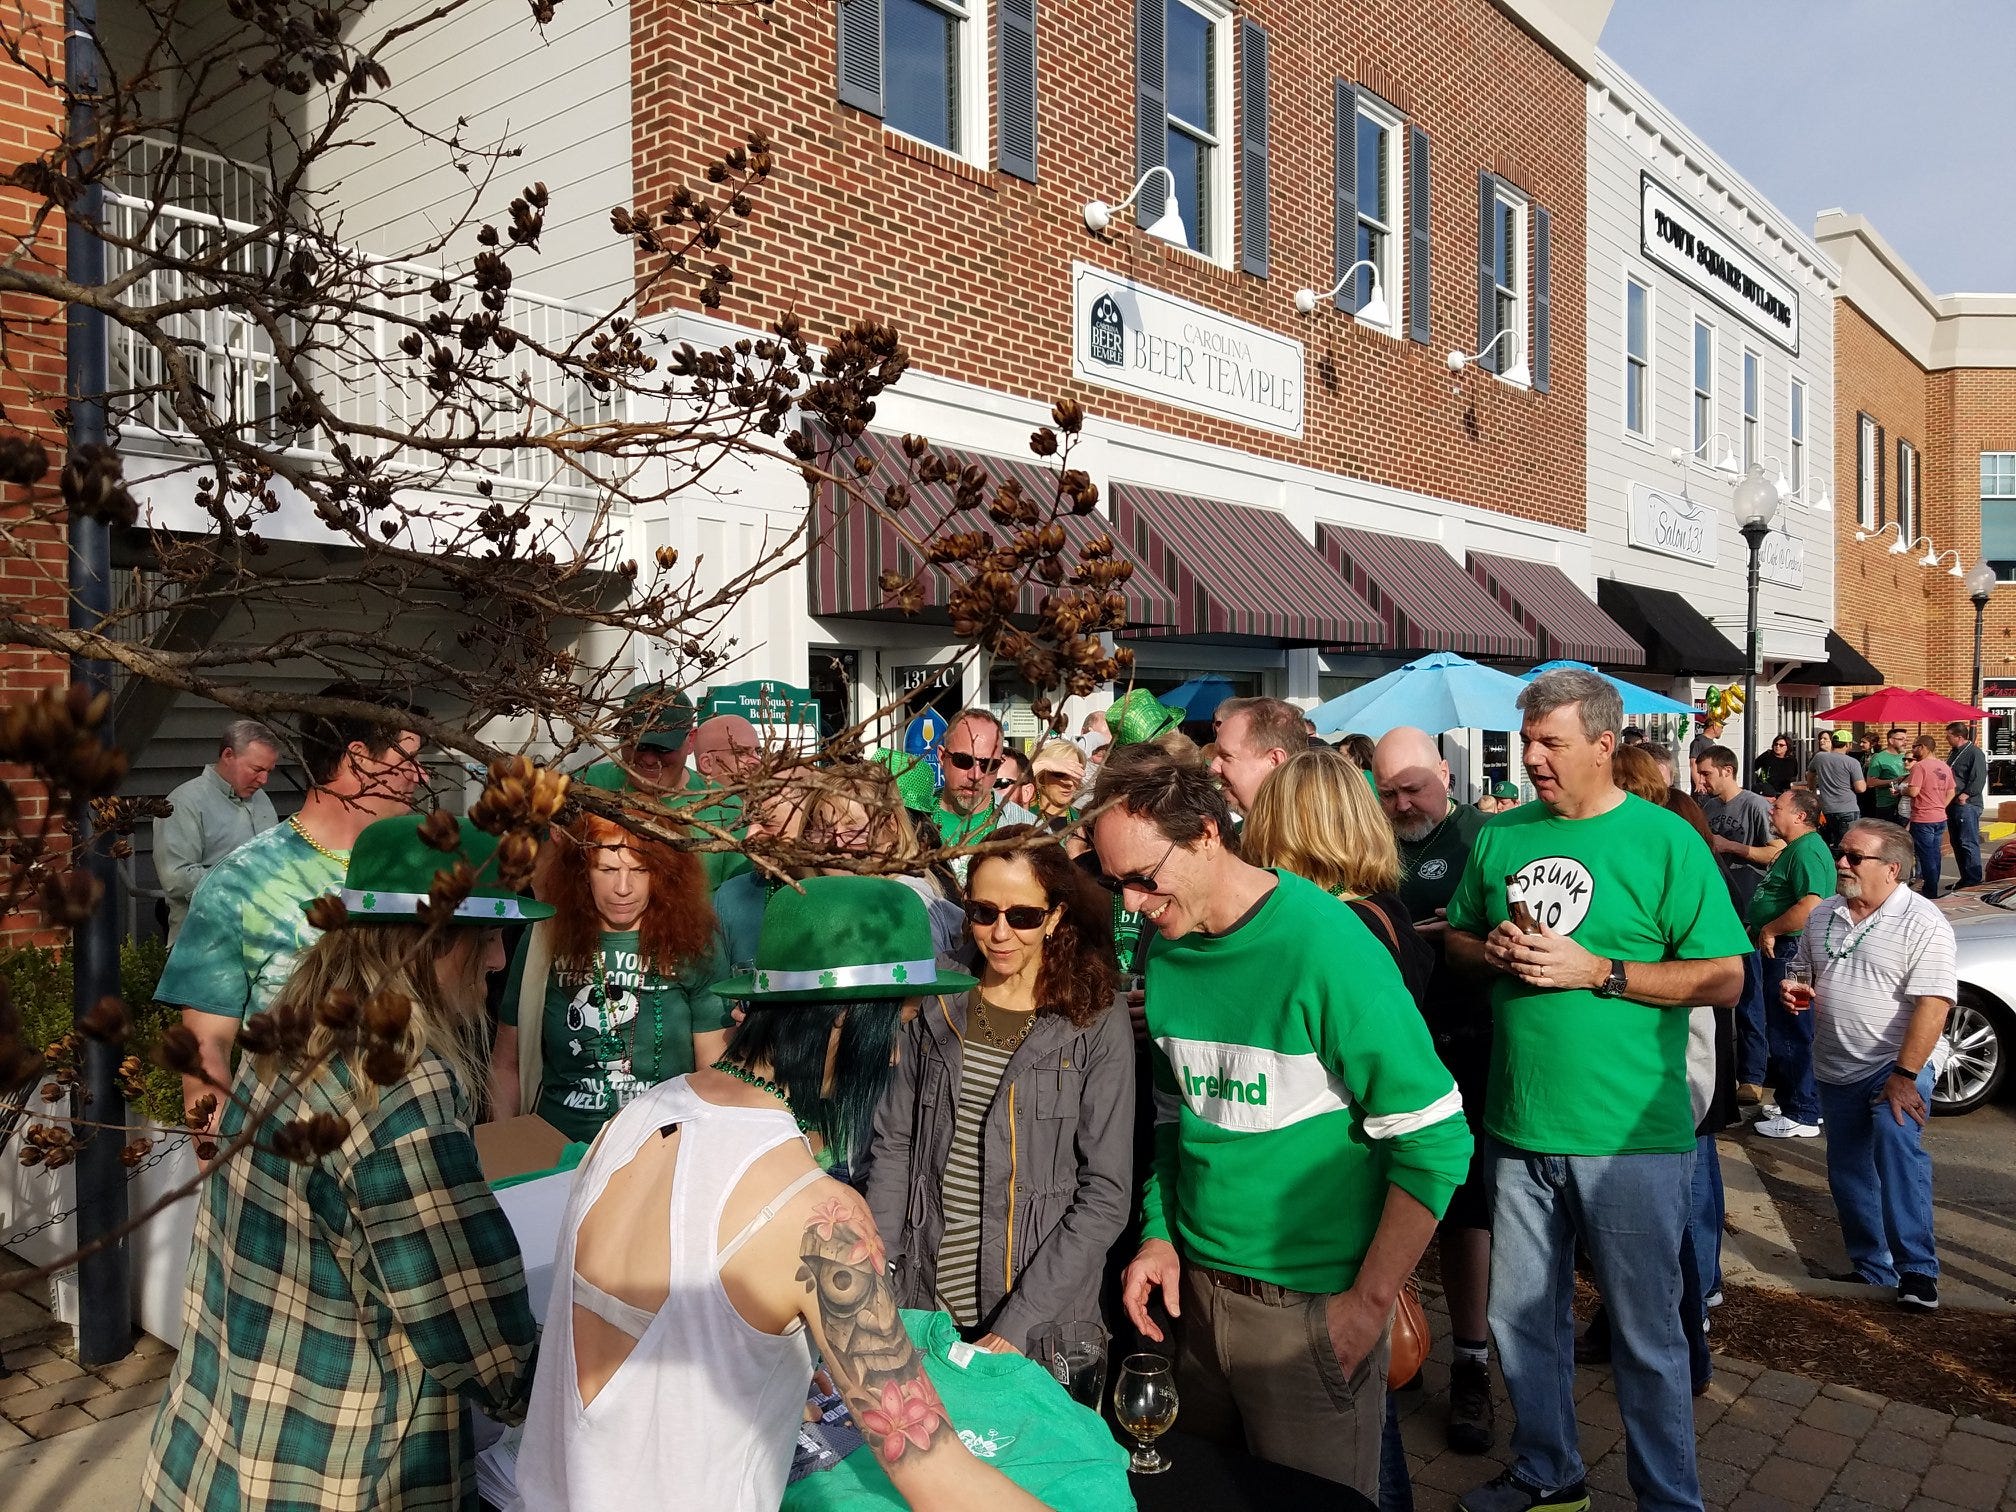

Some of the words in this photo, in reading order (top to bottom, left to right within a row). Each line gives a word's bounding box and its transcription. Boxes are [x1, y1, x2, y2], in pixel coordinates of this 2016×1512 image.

[1655, 208, 1695, 259] TOWN
[1697, 240, 1741, 293] SQUARE
[1742, 273, 1791, 328] BUILDING
[1092, 325, 1122, 353] BEER
[1093, 345, 1123, 364] TEMPLE
[1183, 322, 1251, 362] CAROLINA
[1133, 328, 1196, 385] BEER
[1203, 352, 1294, 413] TEMPLE
[1518, 862, 1588, 904] DRUNK
[1533, 900, 1562, 928] 10
